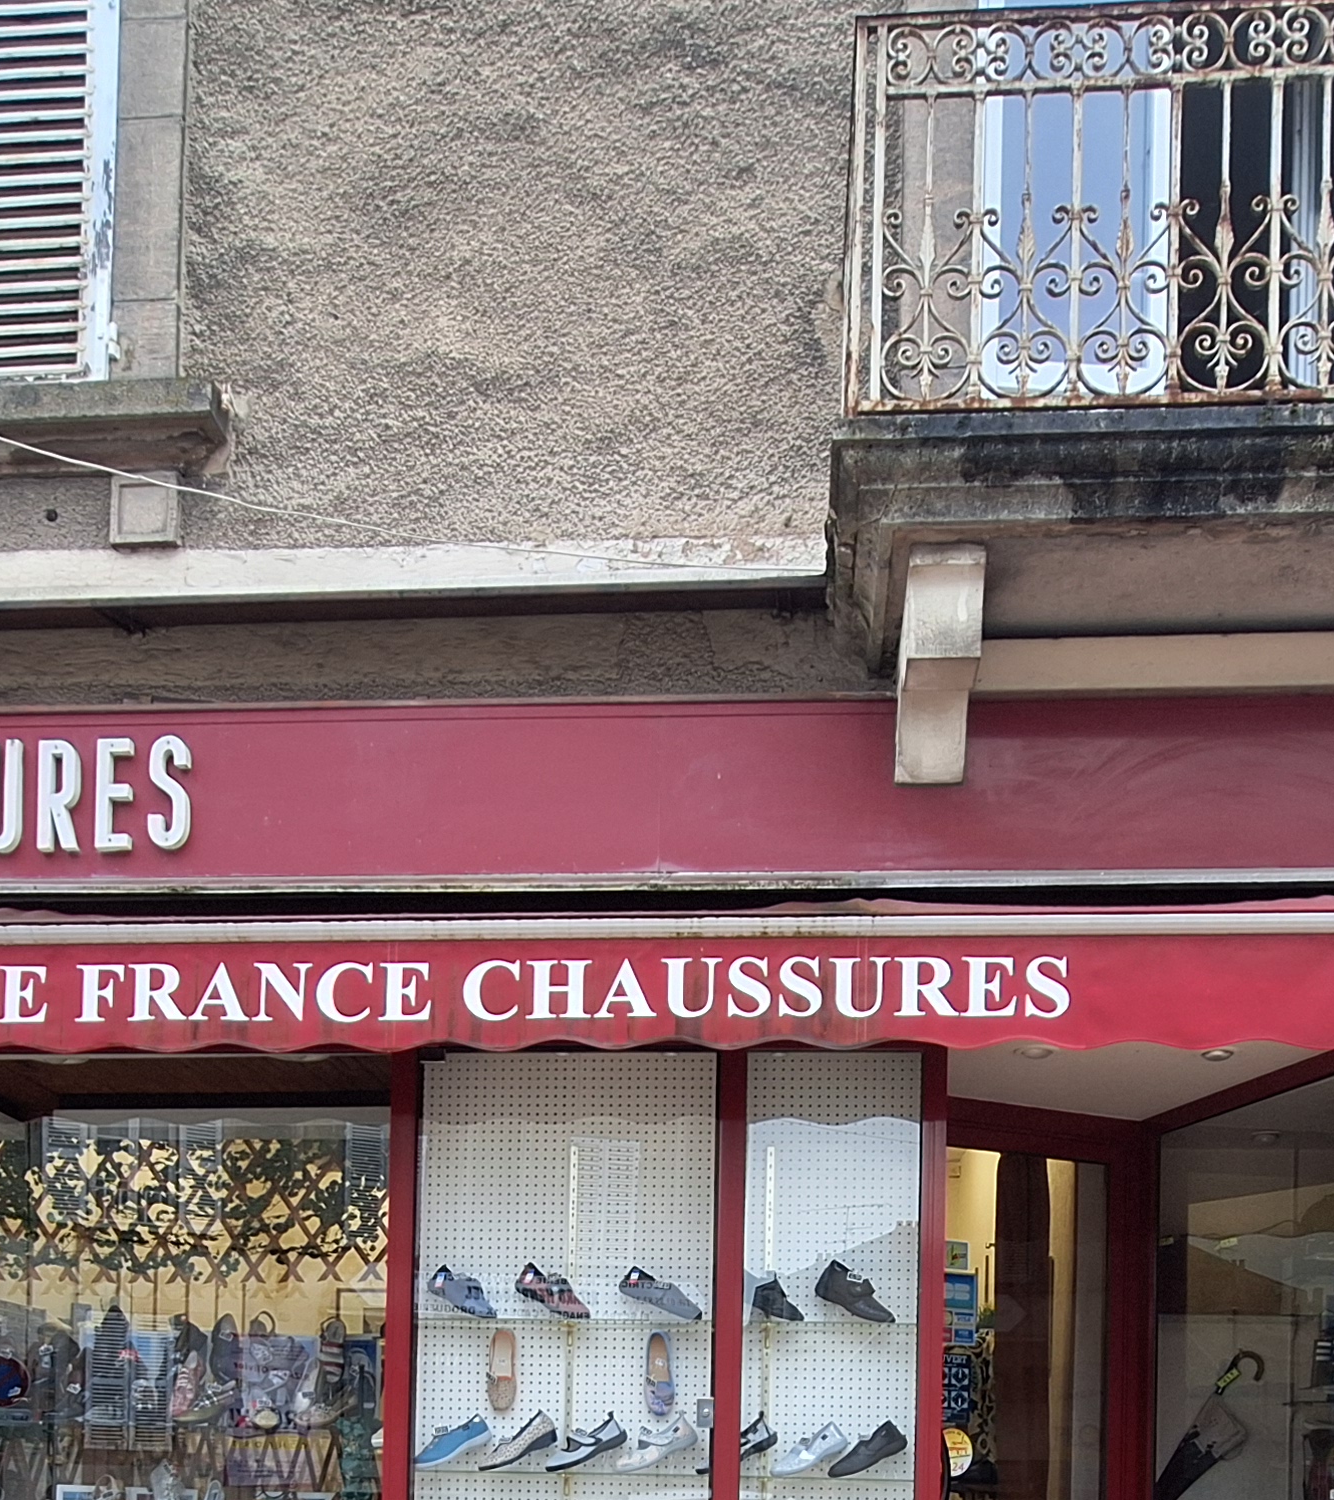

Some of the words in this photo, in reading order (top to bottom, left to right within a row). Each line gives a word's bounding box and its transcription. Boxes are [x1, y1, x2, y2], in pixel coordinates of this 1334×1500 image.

[75, 961, 431, 1023] FRANCE
[461, 955, 1071, 1021] CHAUSSURES
[944, 1355, 968, 1364] VERT
